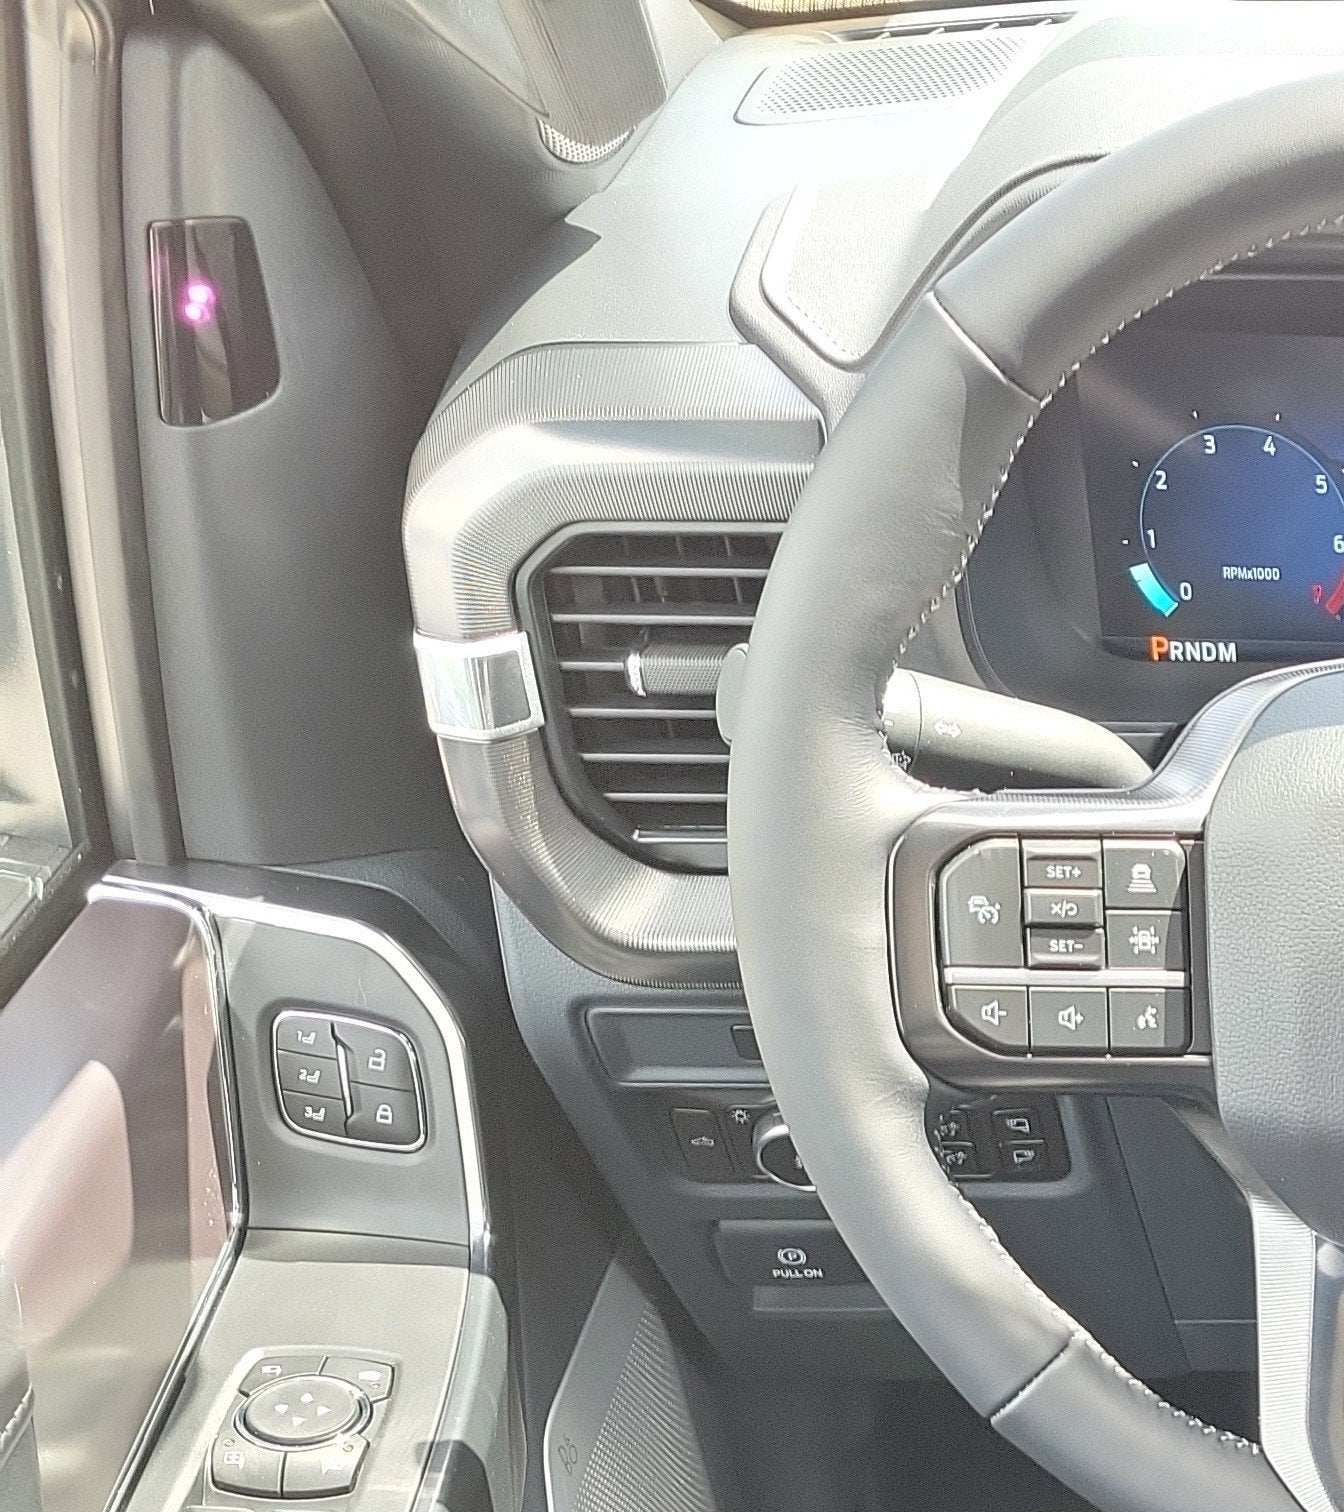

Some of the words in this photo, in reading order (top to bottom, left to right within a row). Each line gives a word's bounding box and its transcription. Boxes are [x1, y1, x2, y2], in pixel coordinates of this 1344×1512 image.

[1204, 435, 1216, 454] 3
[1263, 436, 1276, 456] 4
[1155, 471, 1168, 490] 2
[1314, 475, 1328, 494] 5
[1146, 530, 1156, 549] 1
[1333, 535, 1344, 553] 6
[1222, 565, 1280, 581] RPMx1000
[1179, 582, 1193, 600] 0
[772, 1268, 803, 1279] PULL
[803, 1268, 824, 1279] ON
